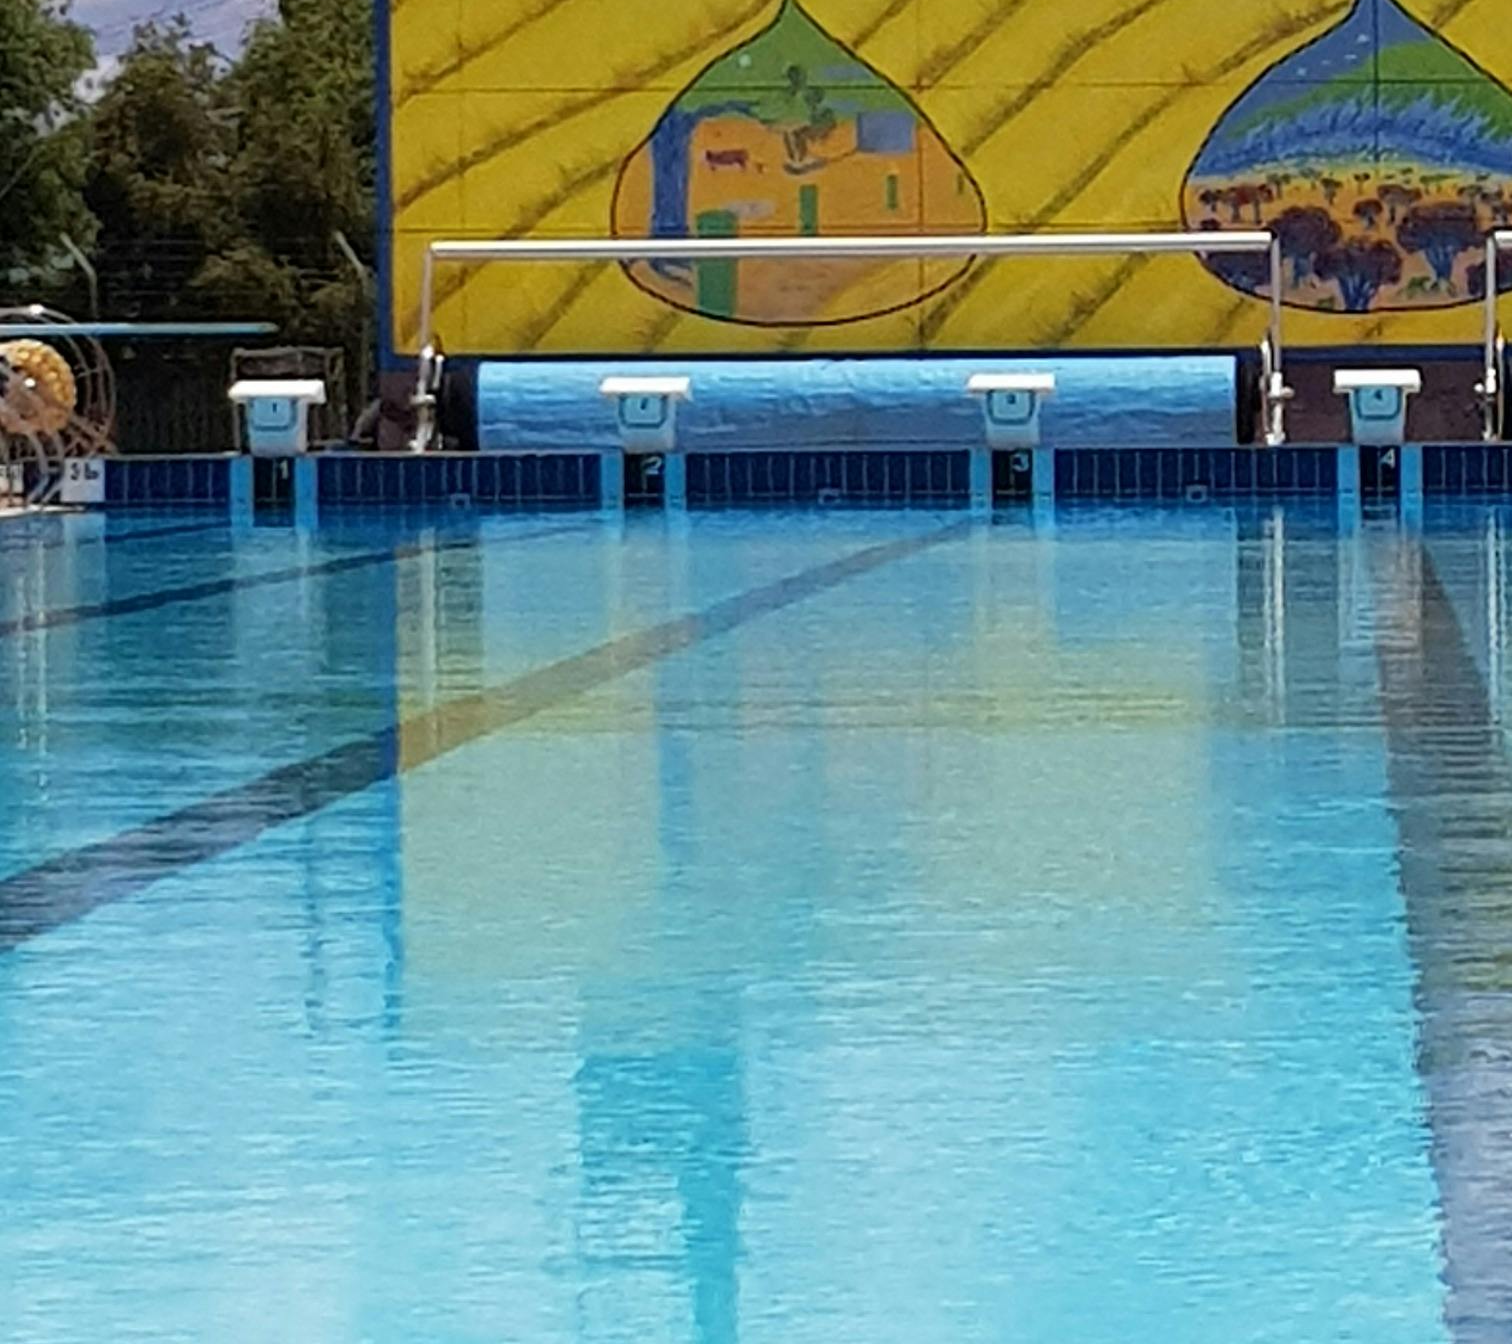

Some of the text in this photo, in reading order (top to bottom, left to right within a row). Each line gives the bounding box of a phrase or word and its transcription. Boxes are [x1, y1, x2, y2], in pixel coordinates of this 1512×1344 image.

[641, 455, 662, 475] 2
[1010, 453, 1030, 472] 3
[1380, 447, 1396, 469] 4
[280, 458, 289, 480] 1
